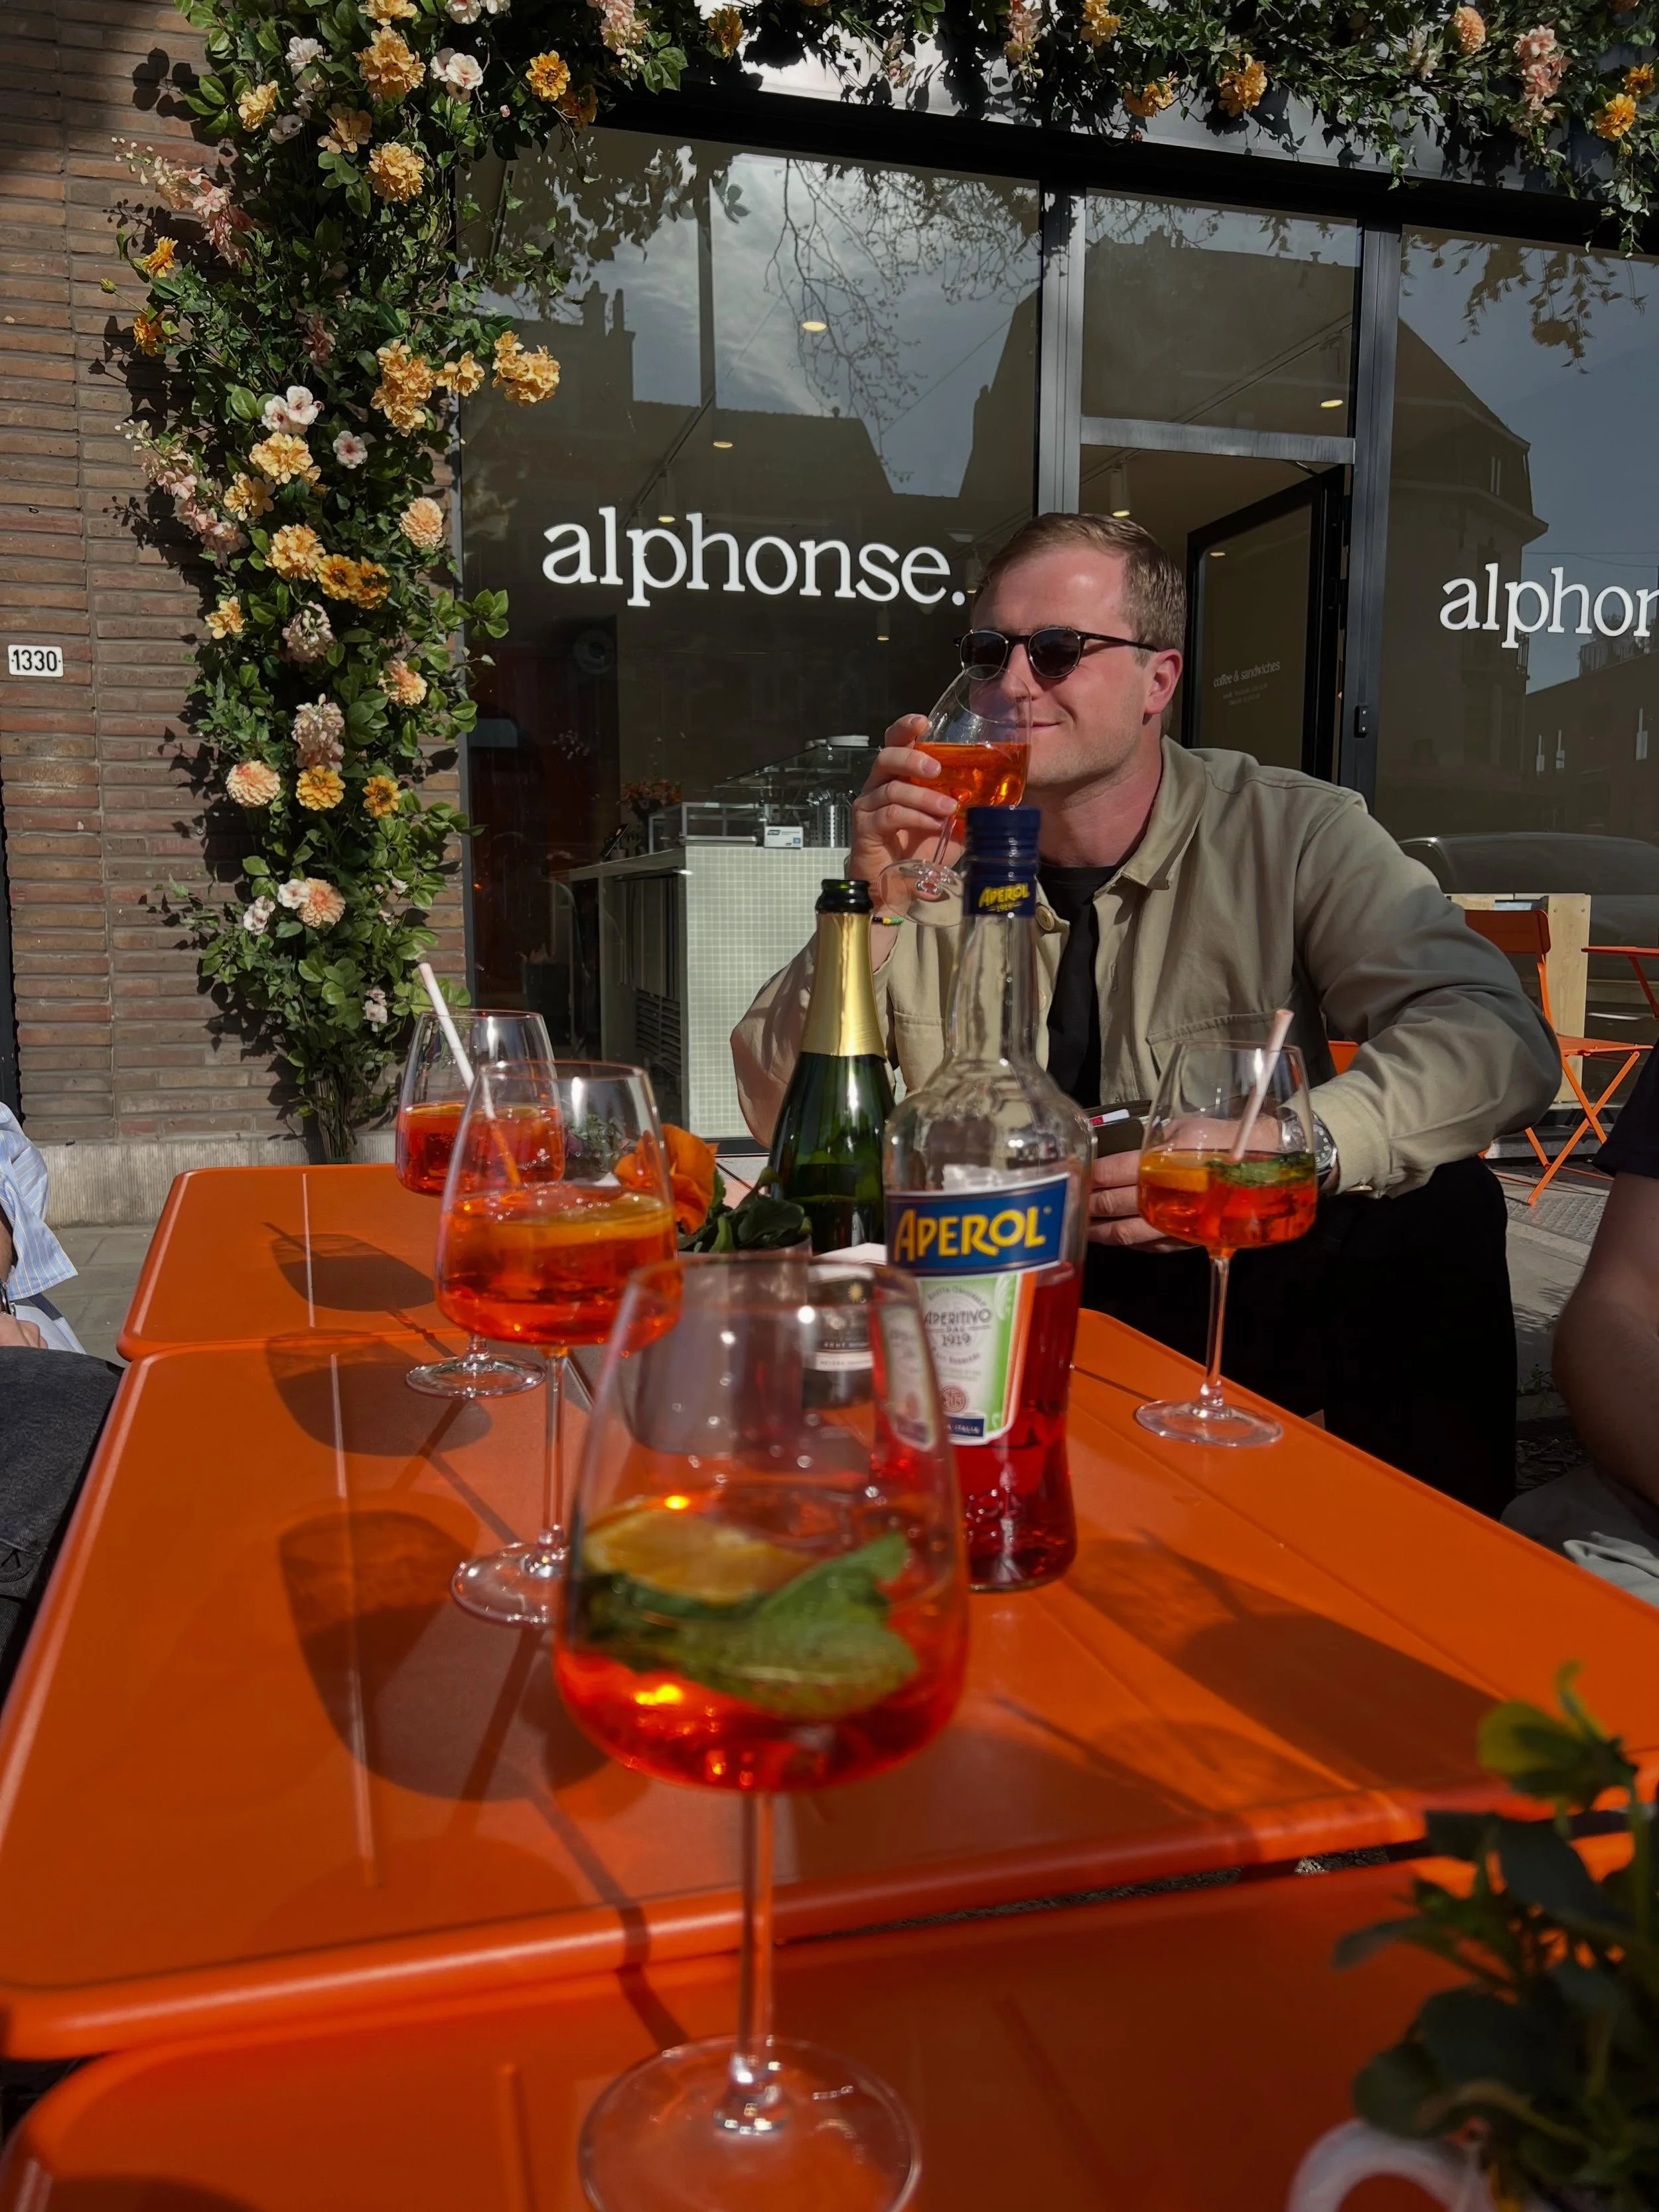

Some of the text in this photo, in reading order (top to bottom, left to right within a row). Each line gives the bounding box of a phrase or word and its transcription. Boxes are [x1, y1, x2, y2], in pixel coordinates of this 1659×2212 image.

[542, 506, 966, 607] alphonse.
[13, 649, 58, 672] 1330
[1213, 661, 1281, 688] coffee & sandwiches
[978, 883, 1029, 908] APEROL
[894, 1206, 1046, 1261] APEROL
[924, 1307, 992, 1325] APERITIVO
[942, 1332, 972, 1347] 1919
